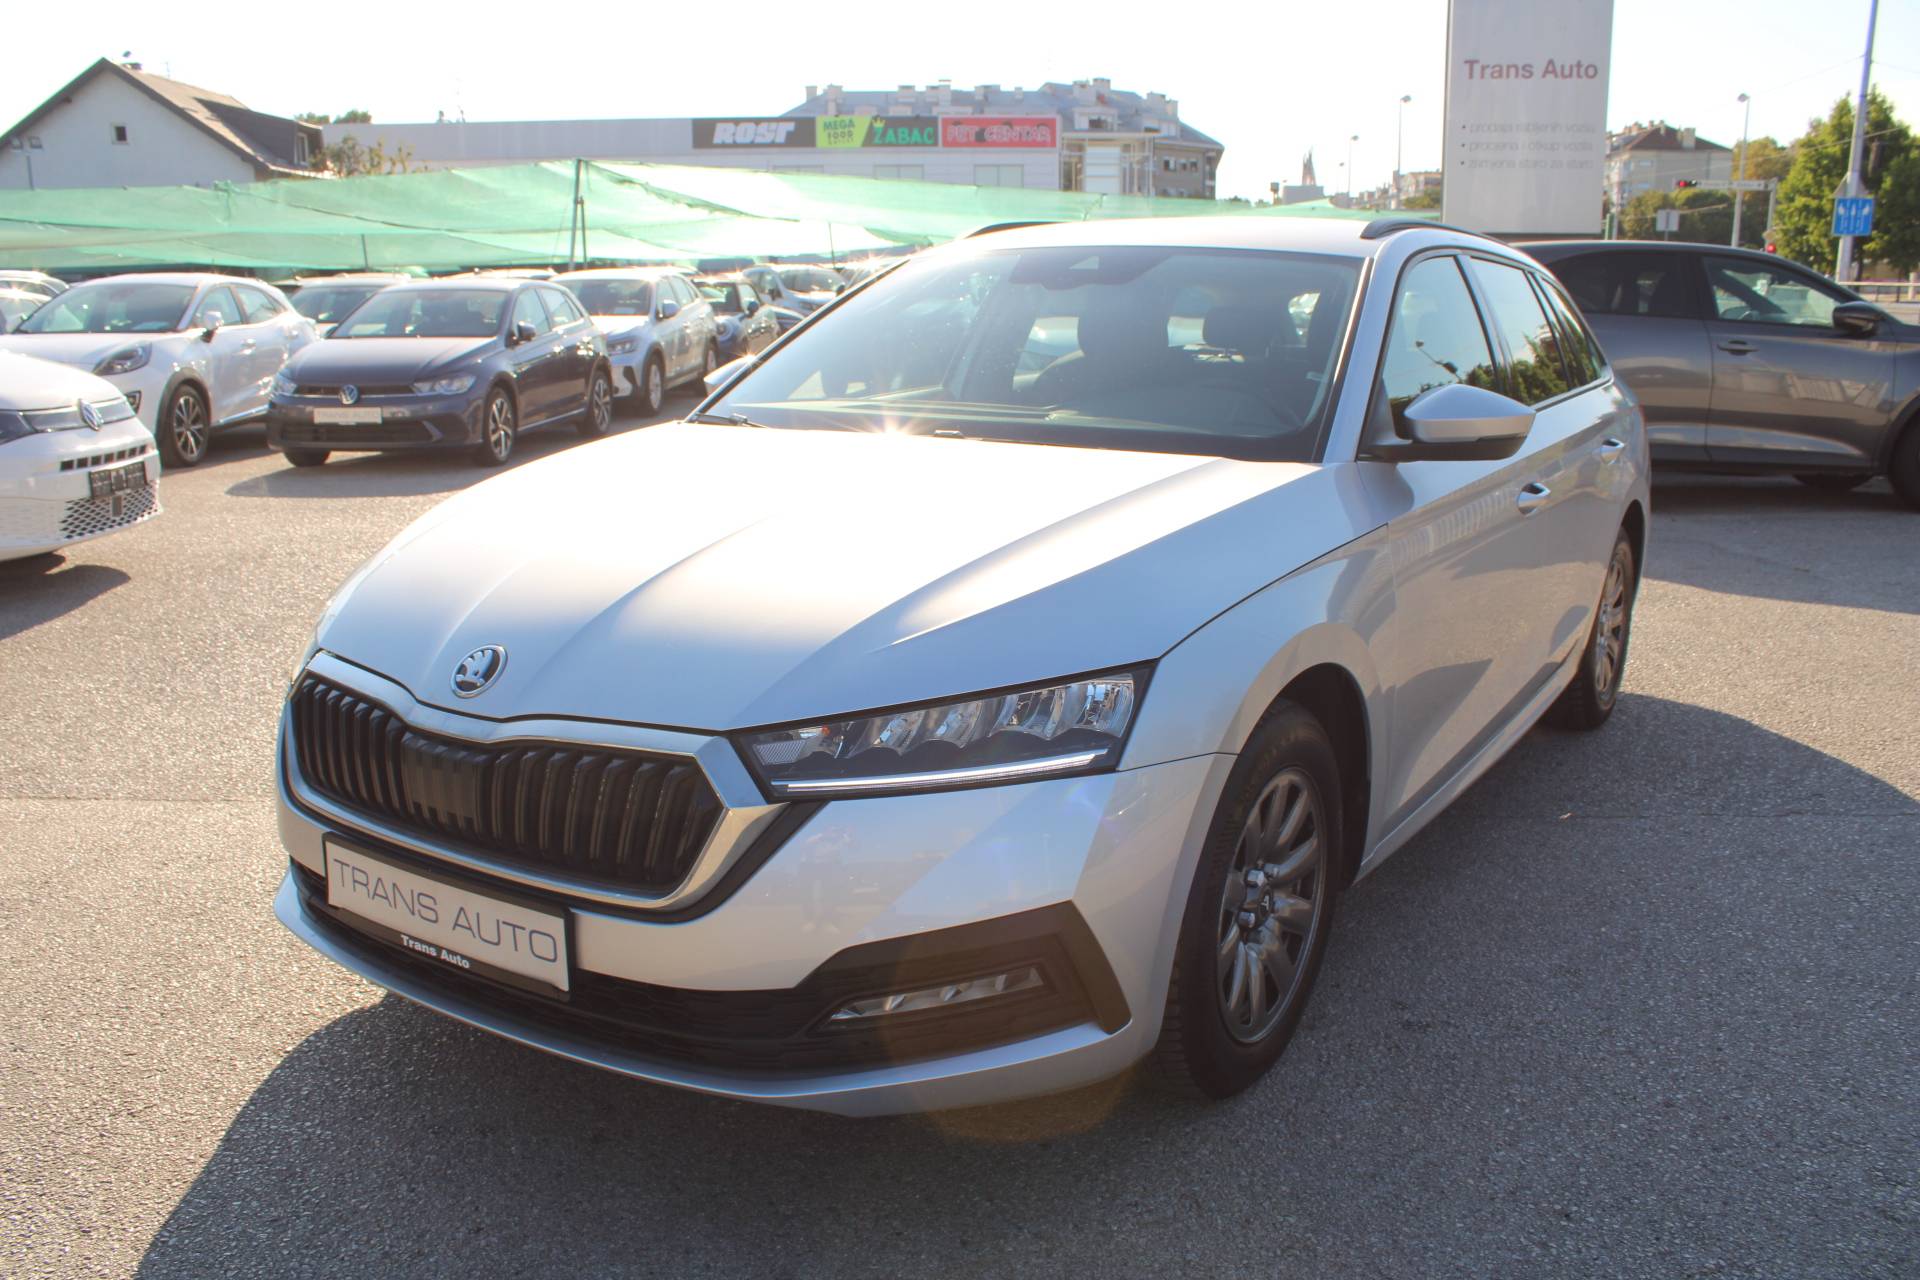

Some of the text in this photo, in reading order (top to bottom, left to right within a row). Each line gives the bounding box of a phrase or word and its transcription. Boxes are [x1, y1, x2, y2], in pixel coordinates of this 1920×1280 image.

[1463, 59, 1598, 80] Trans Auto
[823, 118, 855, 131] MEGA
[947, 125, 1051, 143] PET CENTAR
[334, 858, 558, 963] TRANS AUTO
[400, 934, 470, 969] Trans Auto
